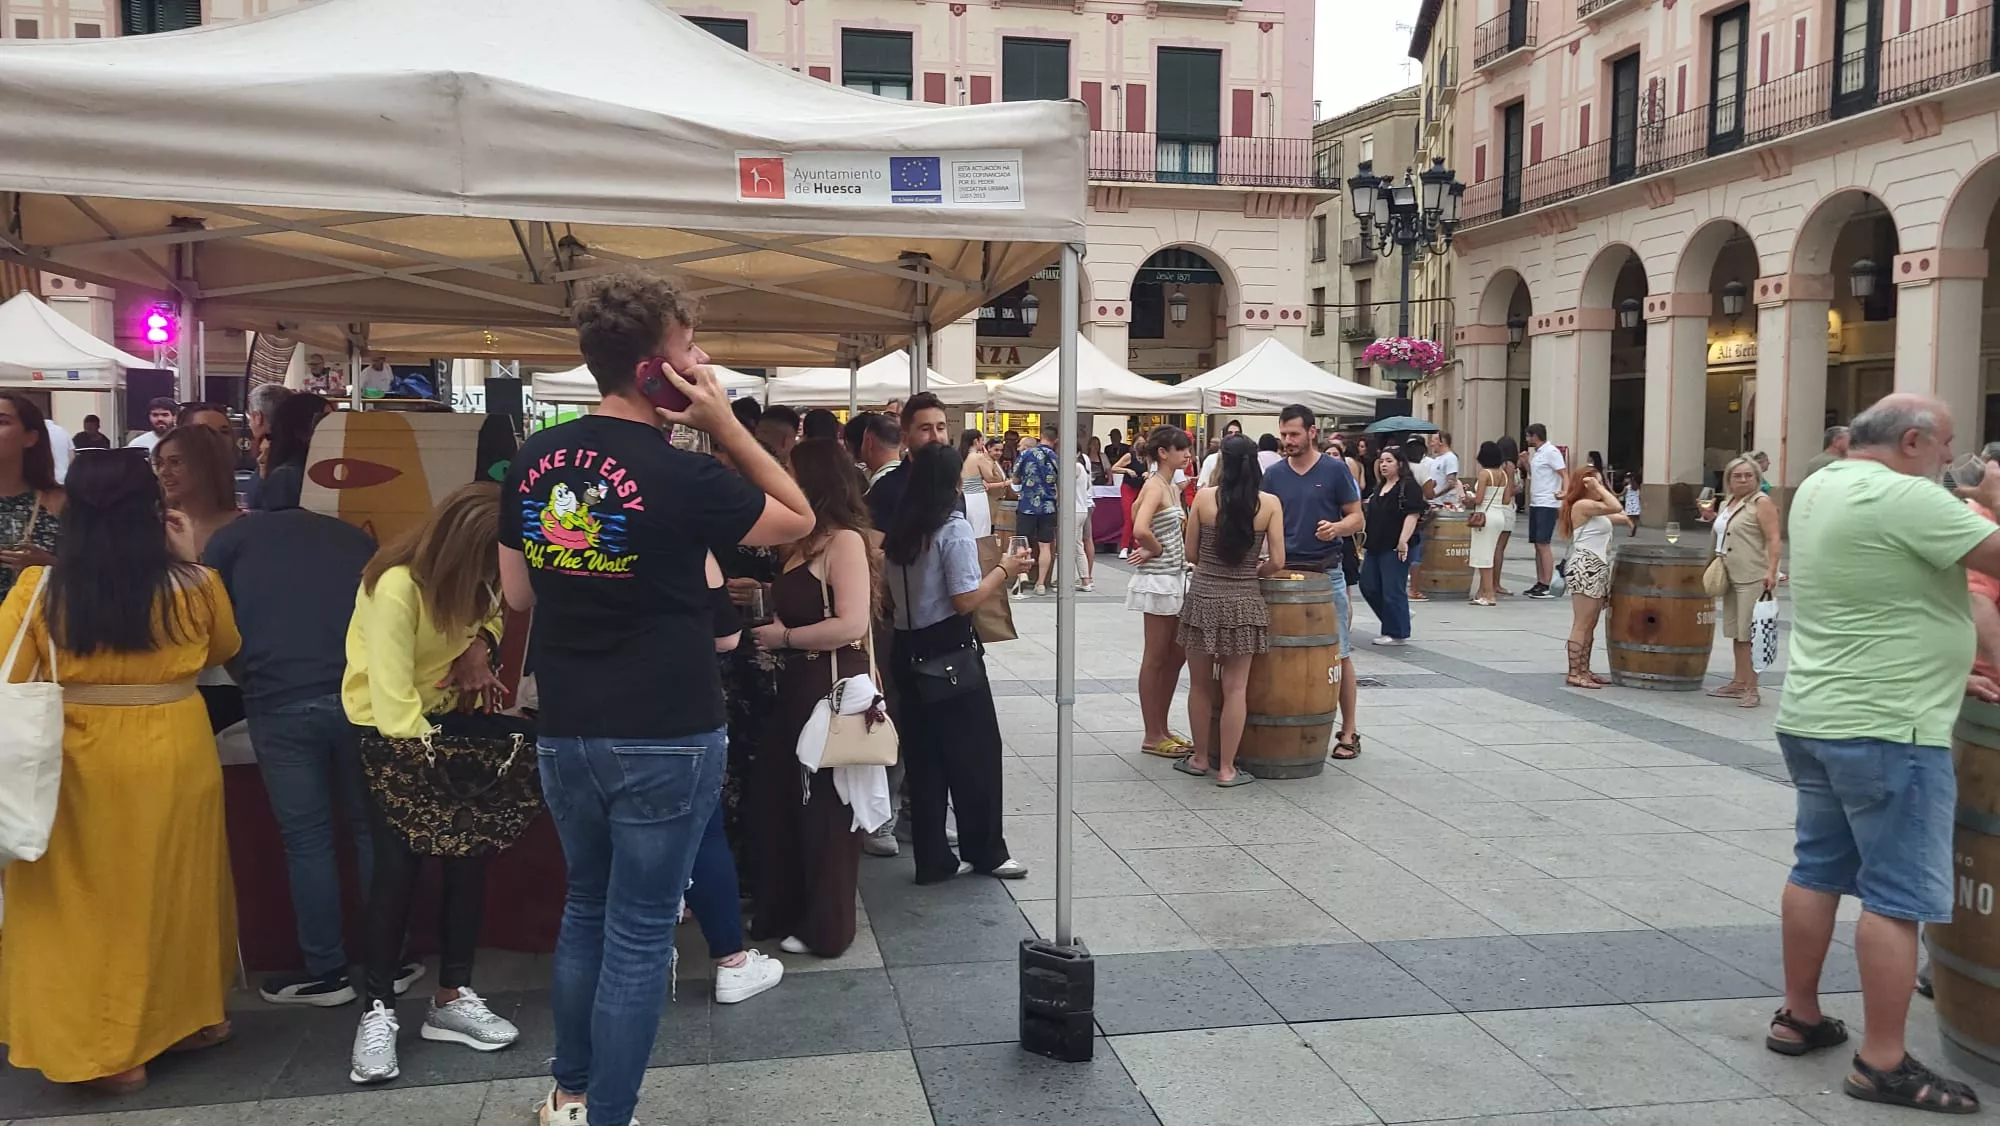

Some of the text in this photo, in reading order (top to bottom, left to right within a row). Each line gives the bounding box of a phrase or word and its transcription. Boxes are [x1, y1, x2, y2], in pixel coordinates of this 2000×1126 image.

[794, 167, 882, 182] Ayuntamiento
[794, 182, 862, 194] de Huesca
[1717, 345, 1732, 359] Alt
[519, 449, 645, 512] TAKE IT EASY
[546, 545, 585, 569] The
